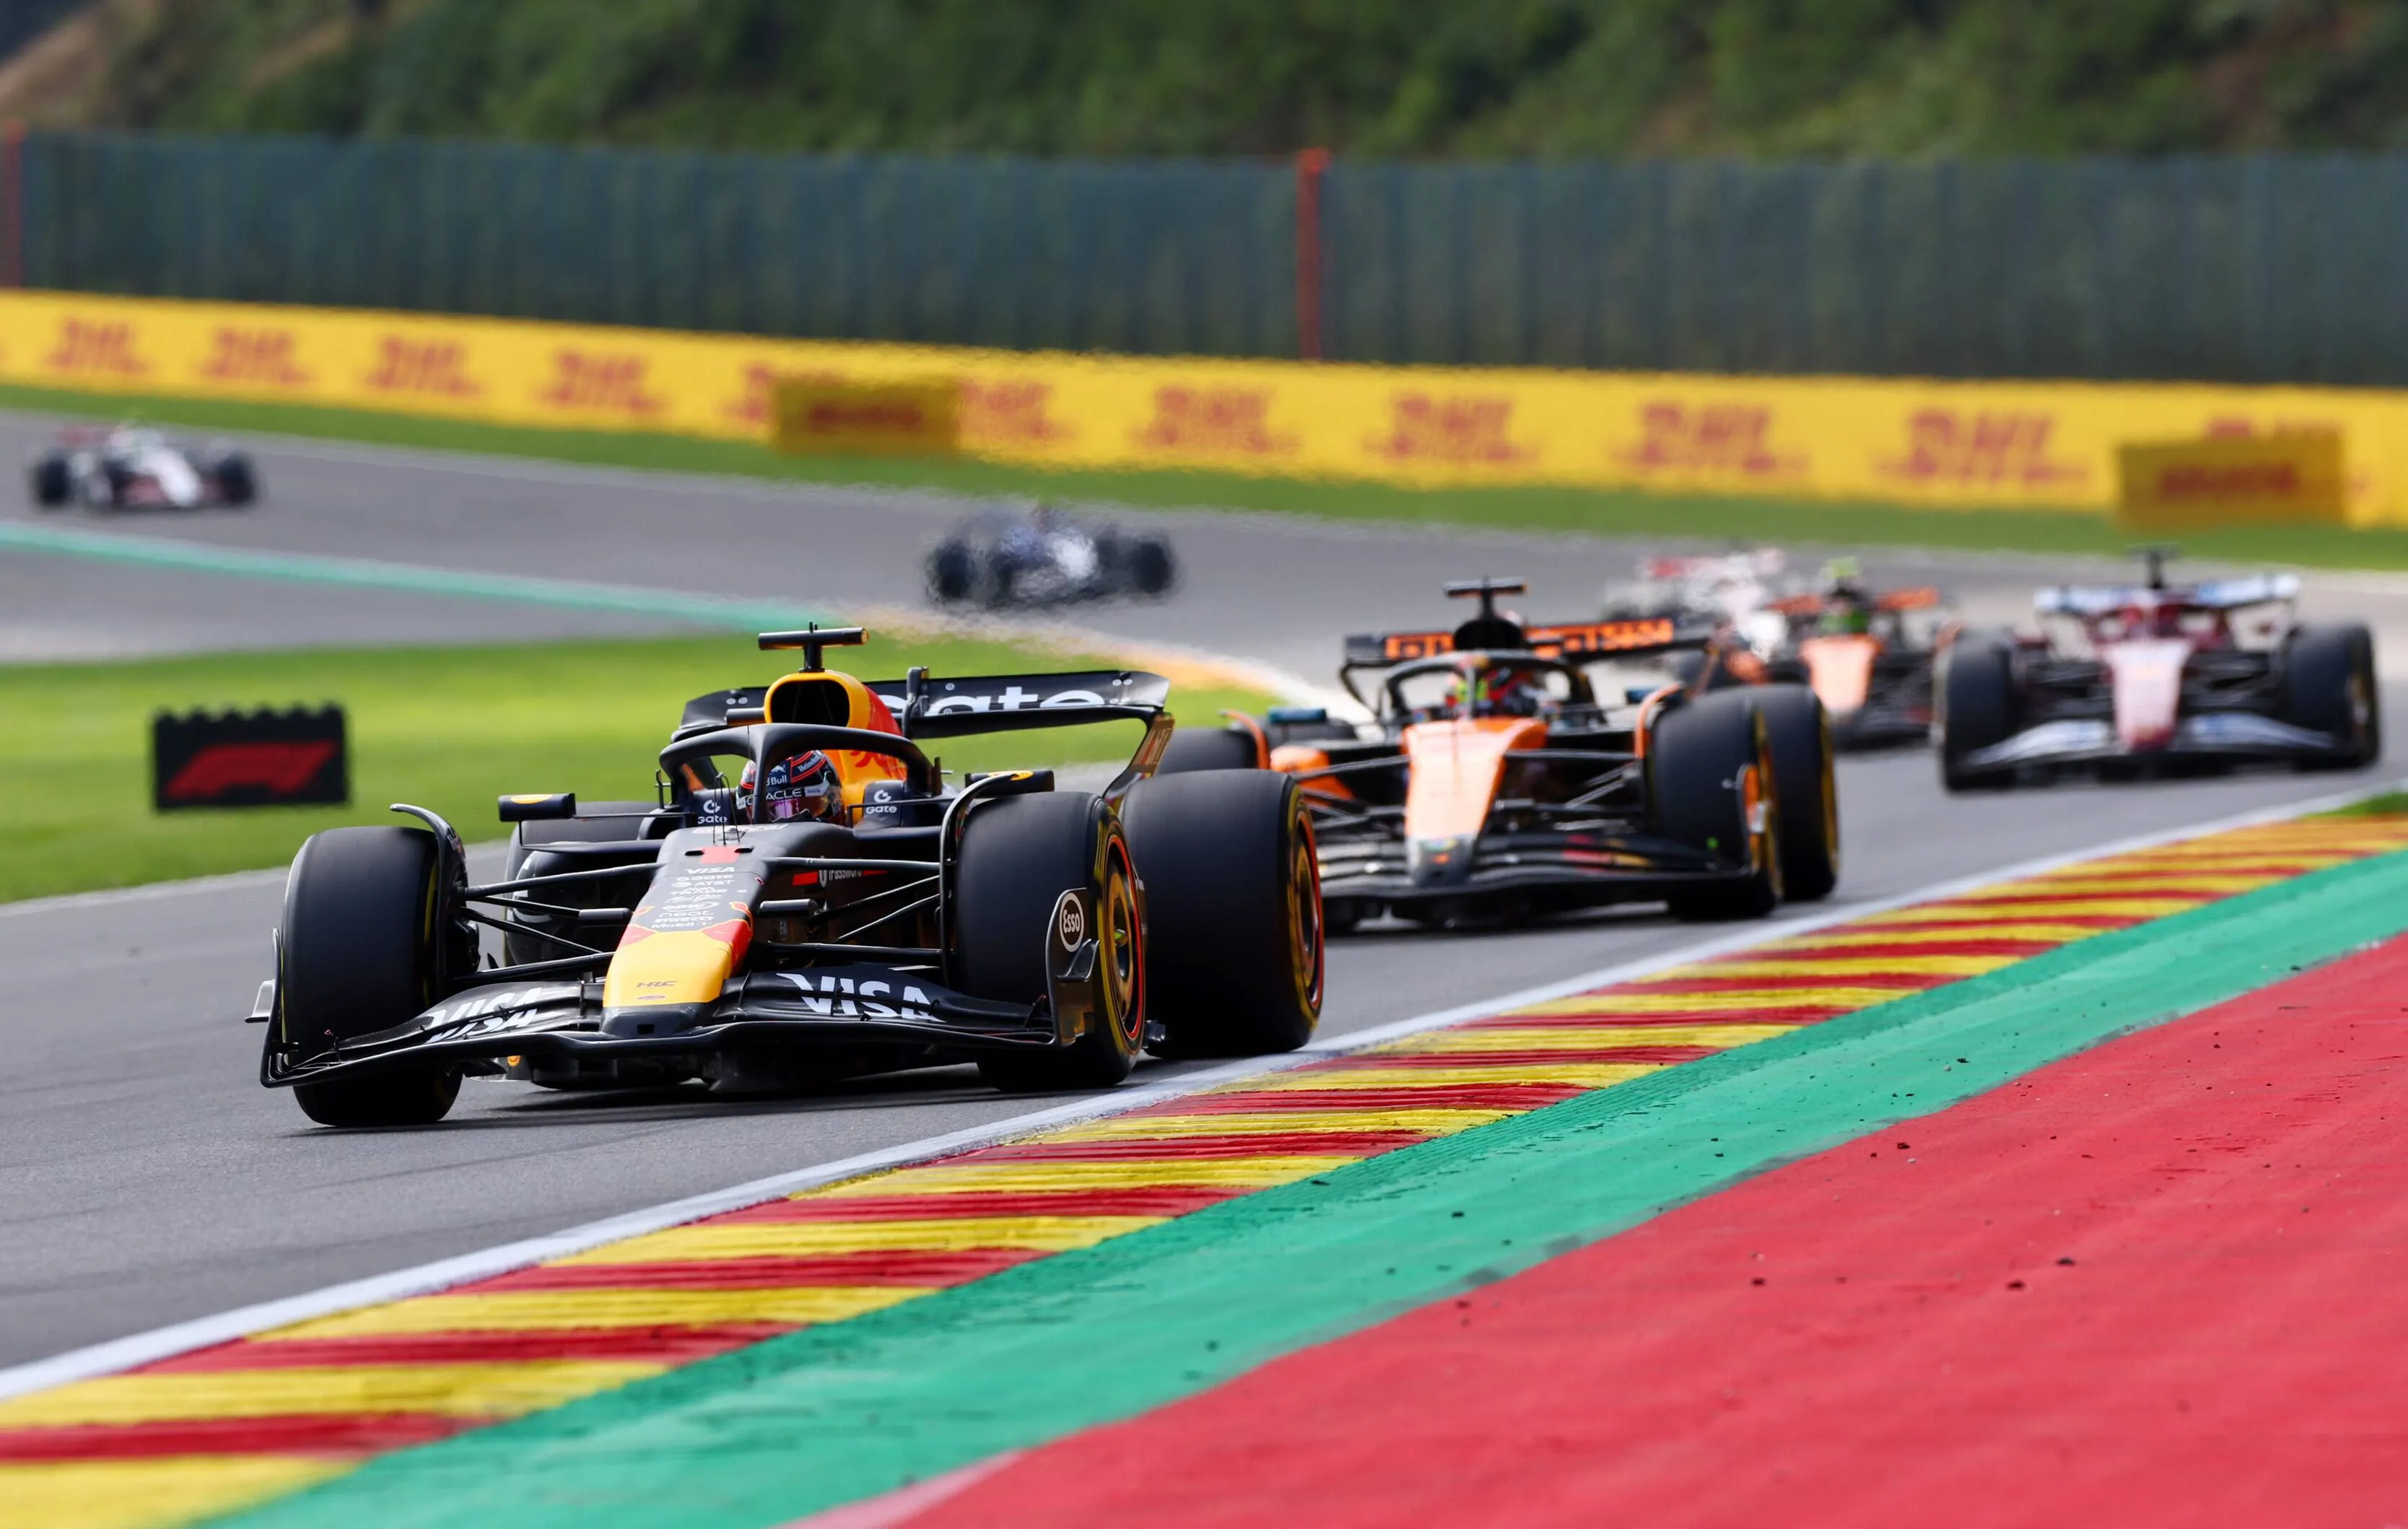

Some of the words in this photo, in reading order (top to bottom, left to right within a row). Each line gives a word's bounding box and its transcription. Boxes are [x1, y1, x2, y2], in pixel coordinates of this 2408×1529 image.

[877, 686, 1105, 715] ate
[771, 775, 788, 785] Bull
[777, 972, 946, 1022] VISA
